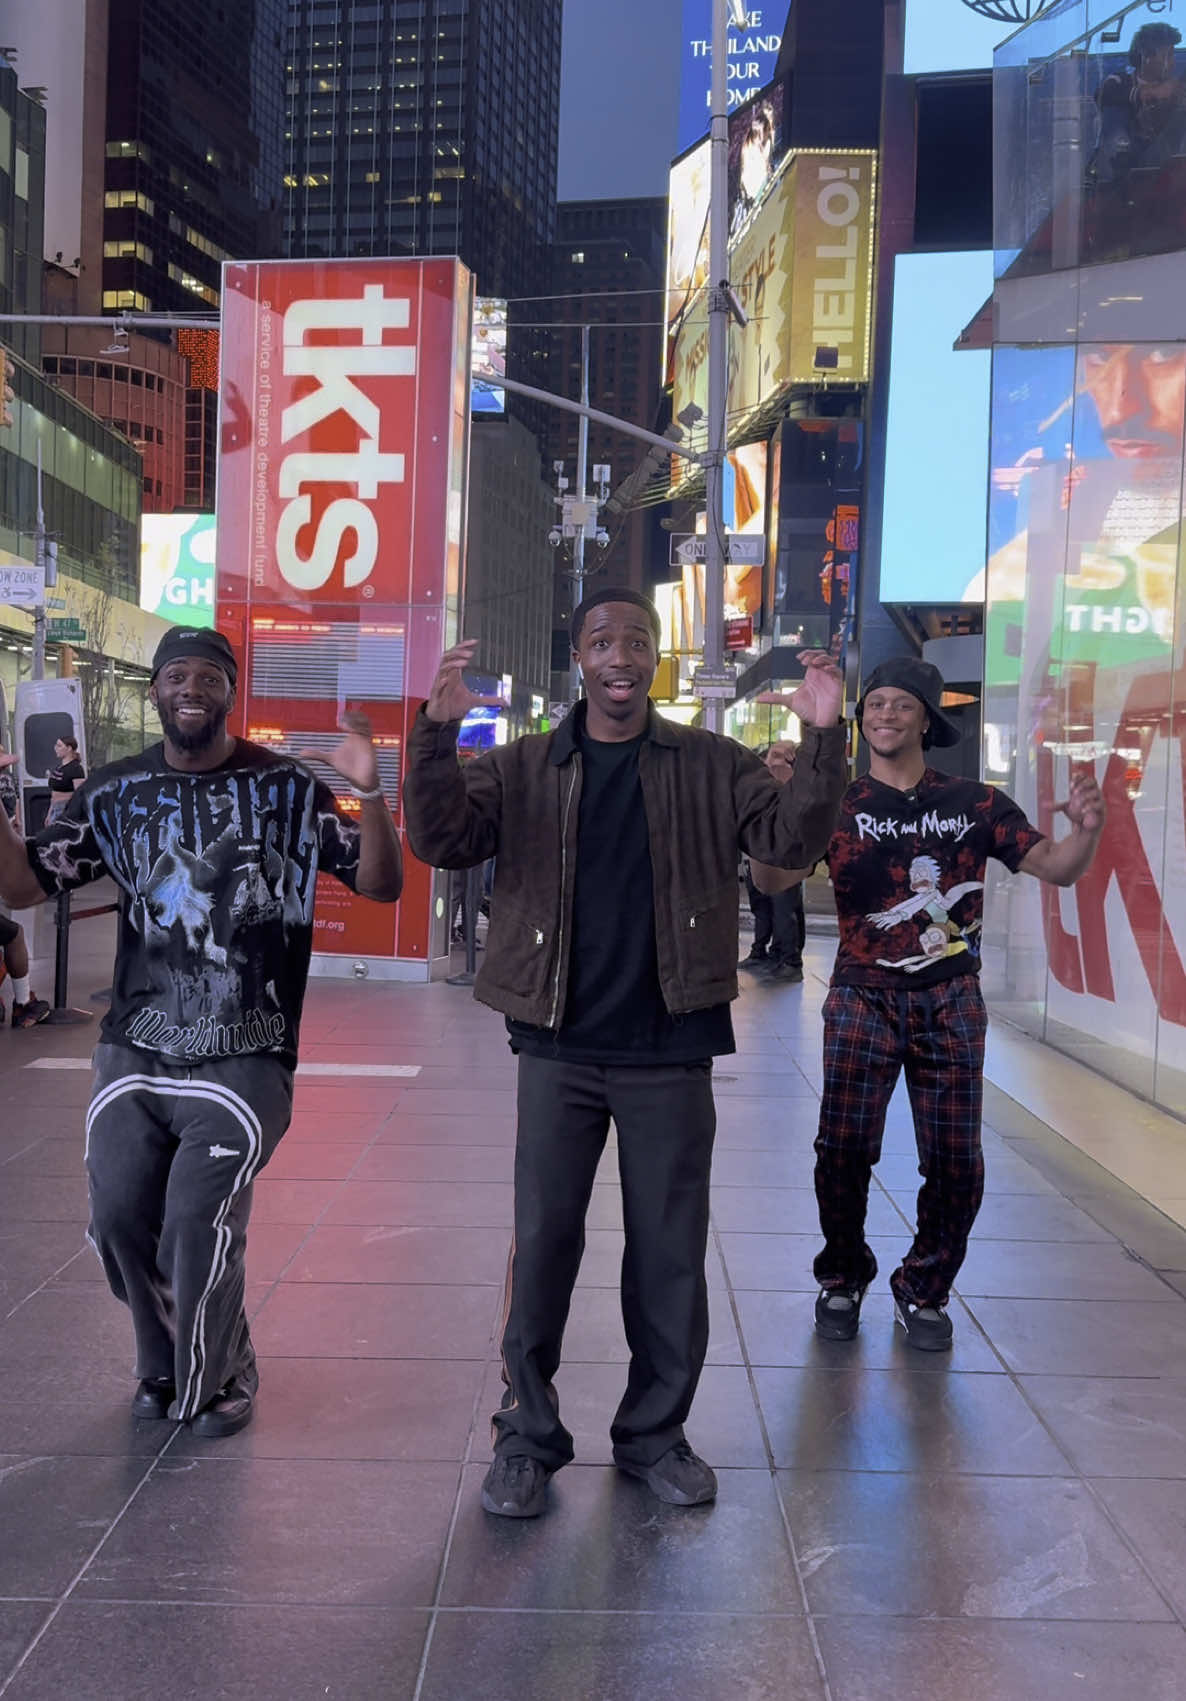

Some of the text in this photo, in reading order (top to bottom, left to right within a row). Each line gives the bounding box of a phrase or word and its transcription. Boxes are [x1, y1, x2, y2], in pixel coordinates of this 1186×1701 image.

[690, 34, 782, 57] THILAND
[709, 62, 760, 79] OUR
[812, 166, 860, 372] HELLO!
[254, 300, 272, 587] a service of theatre development fund
[276, 284, 416, 591] tkts
[125, 1007, 286, 1057] Worldwide
